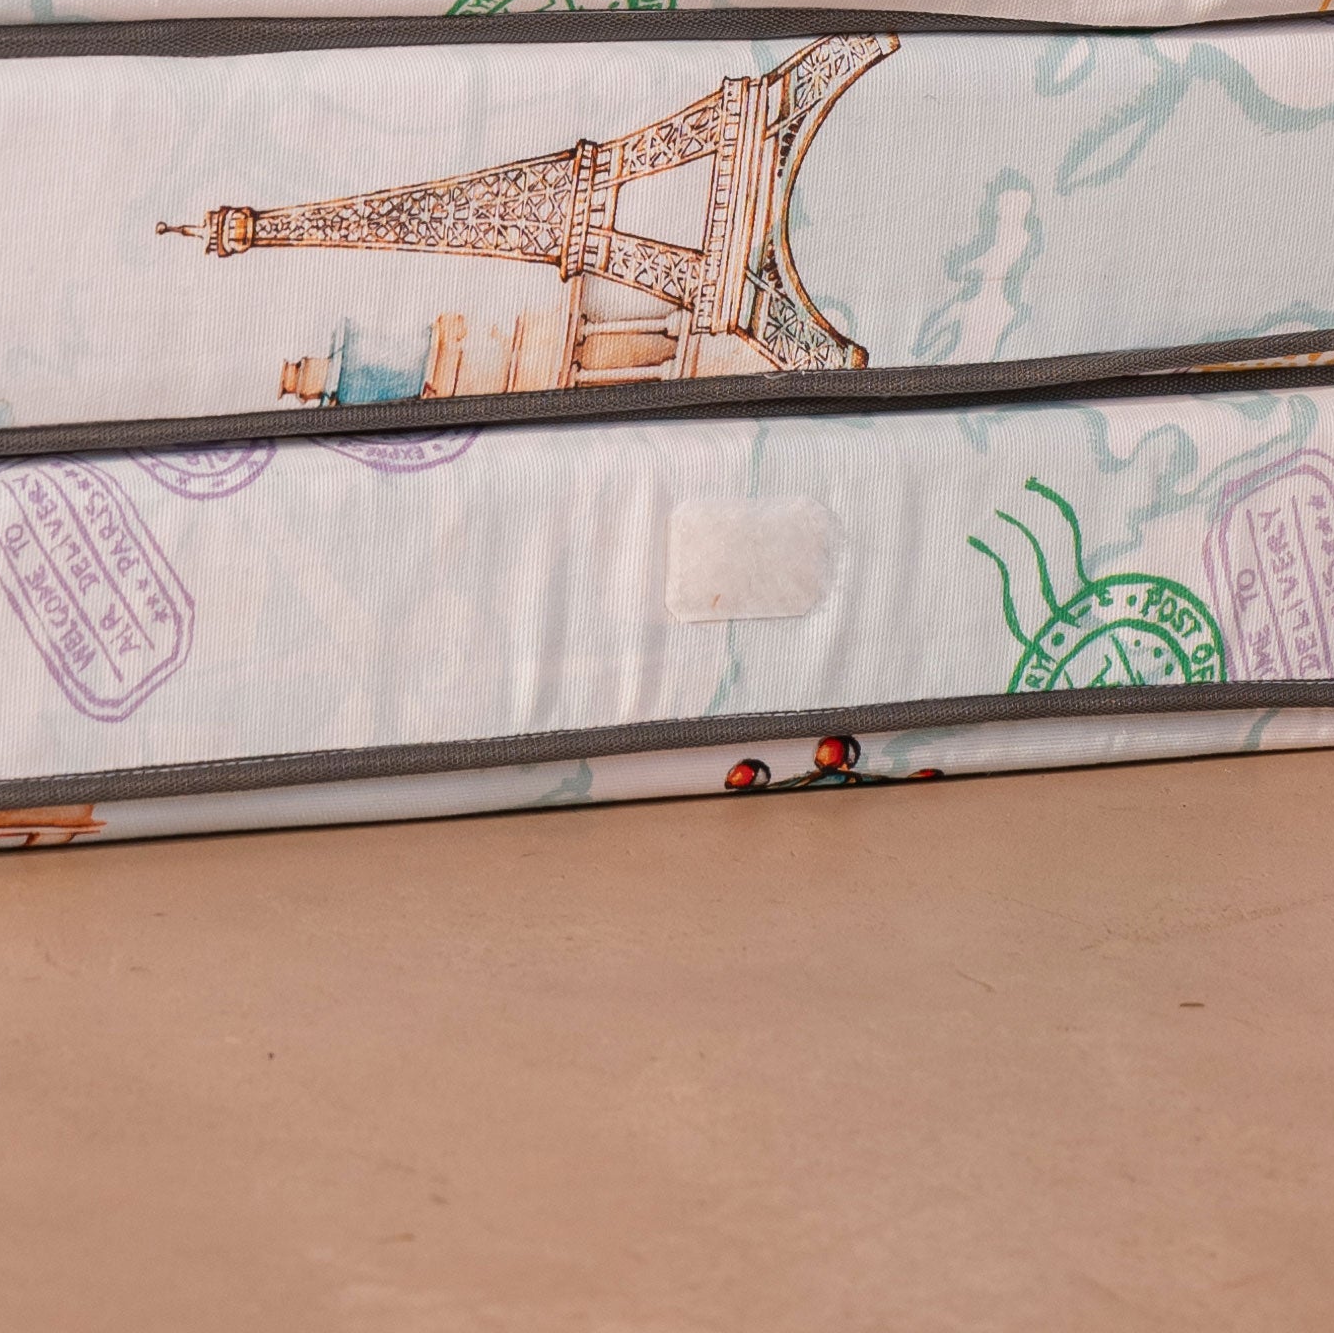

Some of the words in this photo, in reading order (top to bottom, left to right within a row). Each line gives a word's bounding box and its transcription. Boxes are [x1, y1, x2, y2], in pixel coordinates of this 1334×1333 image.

[4, 523, 31, 558] TO
[12, 473, 101, 597] DELIVERY
[84, 490, 141, 578] PARIS
[24, 564, 97, 672] WELCOME
[1139, 585, 1203, 639] POST
[1236, 568, 1259, 612] TO
[1258, 507, 1322, 678] DELIVERY
[99, 603, 142, 656] AIR
